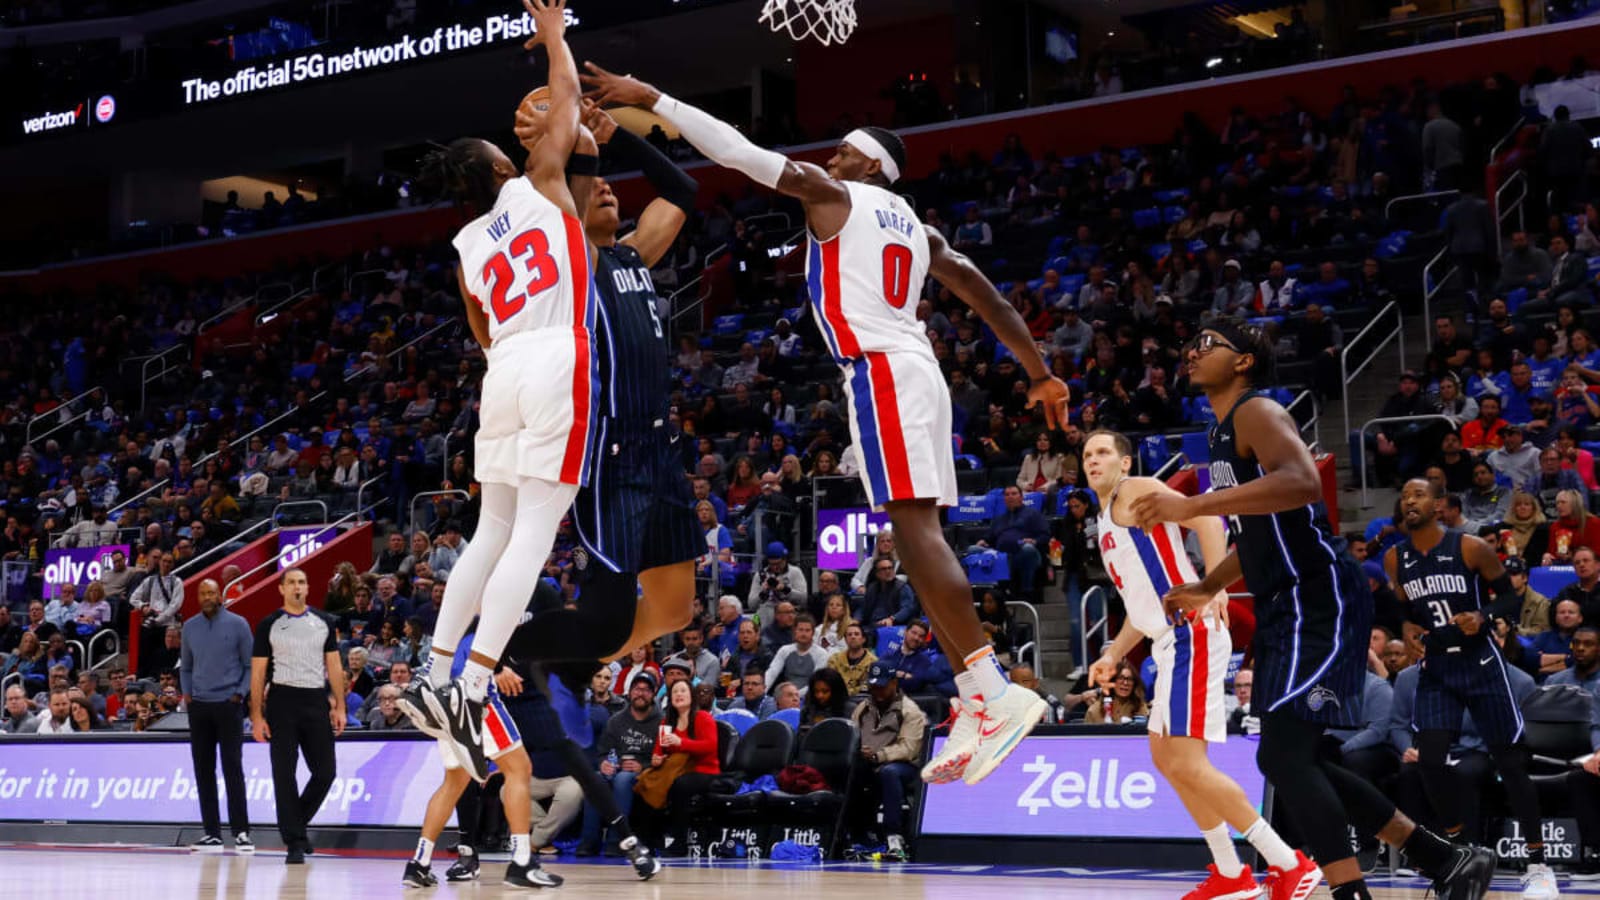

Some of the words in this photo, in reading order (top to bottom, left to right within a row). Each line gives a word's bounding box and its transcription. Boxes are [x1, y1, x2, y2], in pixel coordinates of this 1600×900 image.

[182, 77, 220, 103] The
[222, 59, 291, 95] official
[292, 53, 325, 81] 5G
[327, 34, 418, 76] network
[418, 25, 445, 56] of
[445, 23, 483, 51] the
[486, 8, 579, 43] Pists.
[23, 110, 75, 134] verizon
[486, 211, 511, 242] IVEY
[875, 209, 914, 238] DUREN
[482, 228, 559, 325] 23
[882, 243, 912, 309] 0
[647, 299, 663, 338] 5
[280, 533, 323, 568] all
[44, 555, 85, 585] ally
[1402, 573, 1467, 600] ORLANDO
[1427, 599, 1453, 628] 31
[35, 768, 58, 799] it
[62, 768, 90, 799] in
[91, 776, 166, 809] your
[318, 777, 372, 812] pp.
[1016, 755, 1157, 815] Zelle
[1496, 838, 1574, 858] Caears
